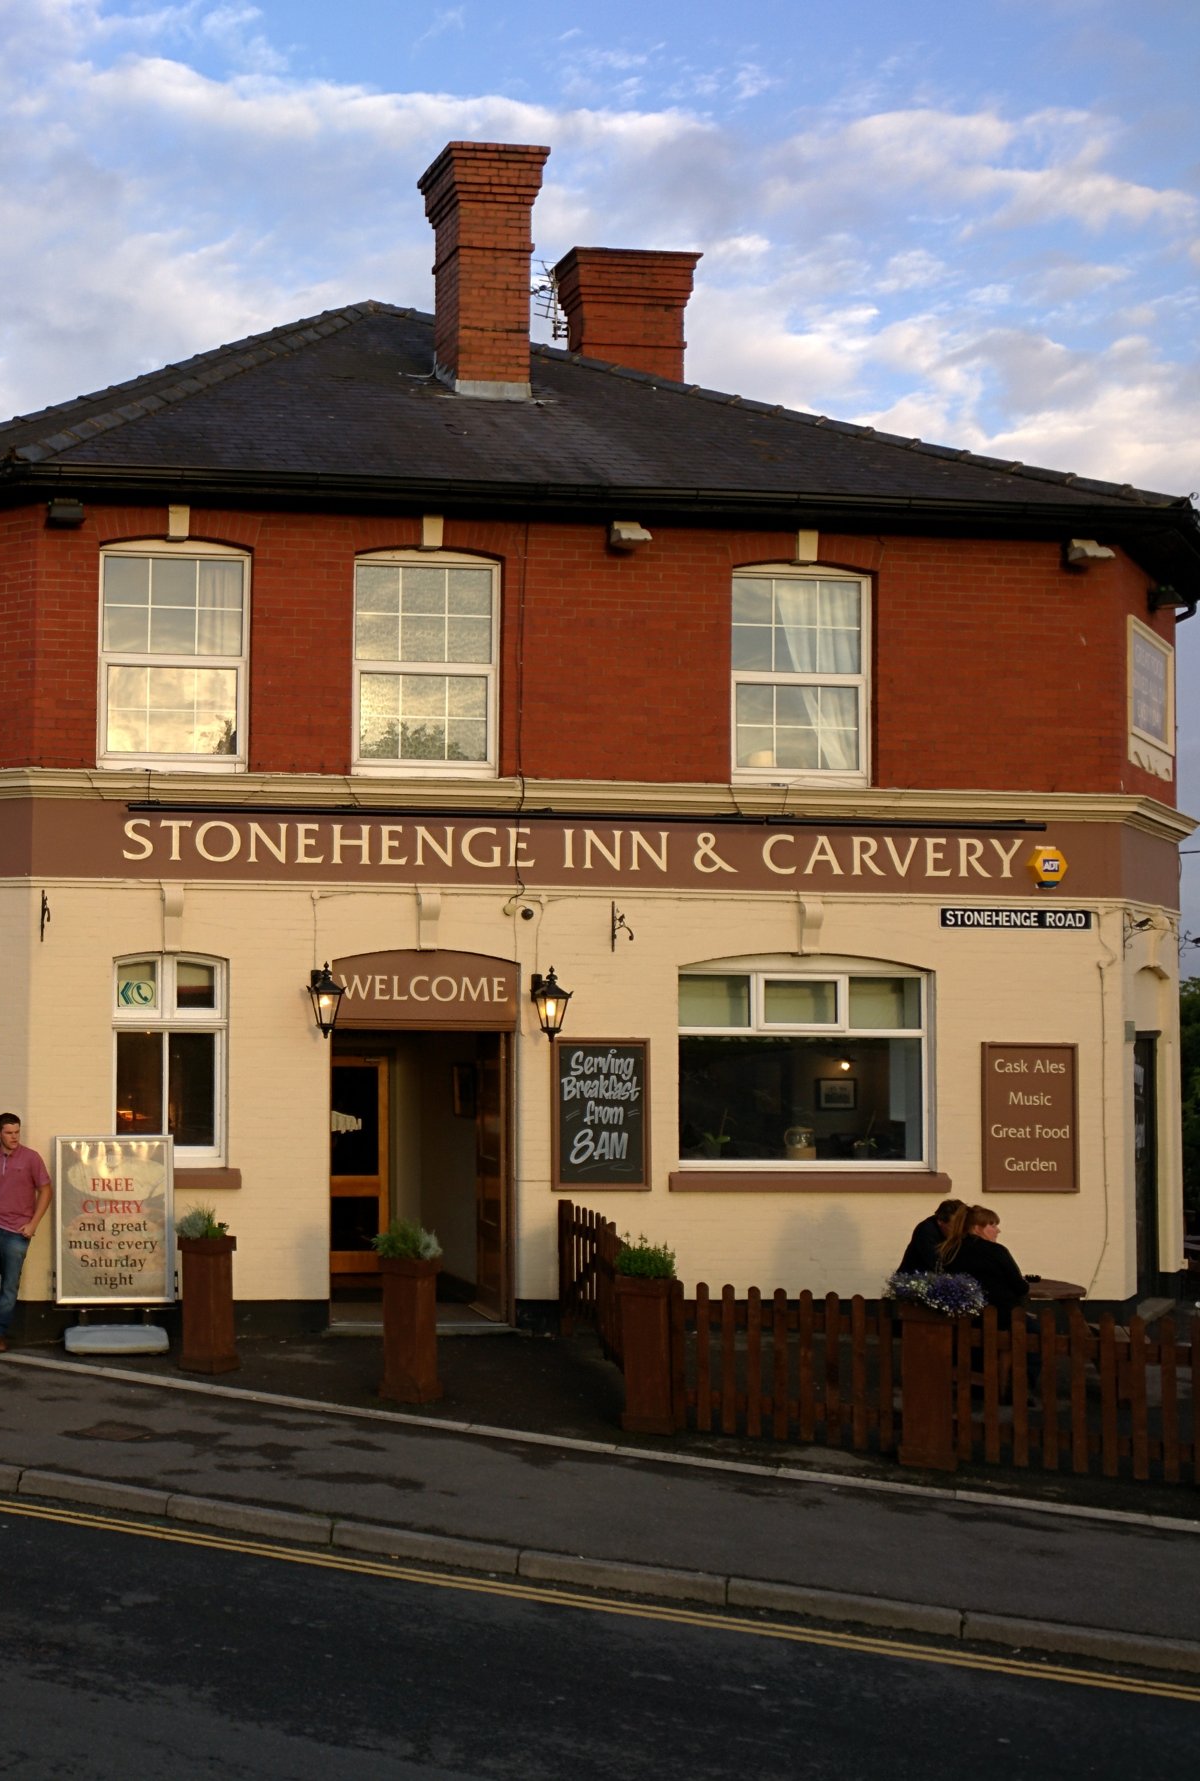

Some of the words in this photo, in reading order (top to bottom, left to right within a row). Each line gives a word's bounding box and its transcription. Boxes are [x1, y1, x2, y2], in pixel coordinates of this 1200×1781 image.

[121, 818, 536, 868] STONEHENGE
[562, 828, 670, 873] INN
[693, 831, 739, 874] &
[761, 833, 1025, 879] CARVERY
[1043, 860, 1060, 872] ADT
[945, 910, 1039, 927] STONEHENGE
[1046, 912, 1086, 928] ROAD
[339, 974, 509, 1002] WELCOME
[570, 1048, 635, 1081] Serving
[994, 1058, 1029, 1073] Cask
[1033, 1059, 1066, 1074] Ales
[561, 1075, 641, 1102] Breakfast
[1008, 1091, 1053, 1106] Music
[584, 1100, 625, 1126] from
[991, 1124, 1031, 1139] Great
[1035, 1124, 1070, 1139] Food
[569, 1128, 629, 1165] 8AM
[1004, 1157, 1058, 1172] Garden
[91, 1177, 135, 1192] FREE
[81, 1199, 145, 1214] CURRY
[79, 1219, 106, 1232] and
[111, 1220, 148, 1237] great
[68, 1237, 113, 1250] music
[117, 1240, 159, 1253] every
[80, 1254, 147, 1272] Saturday
[94, 1272, 134, 1290] night
